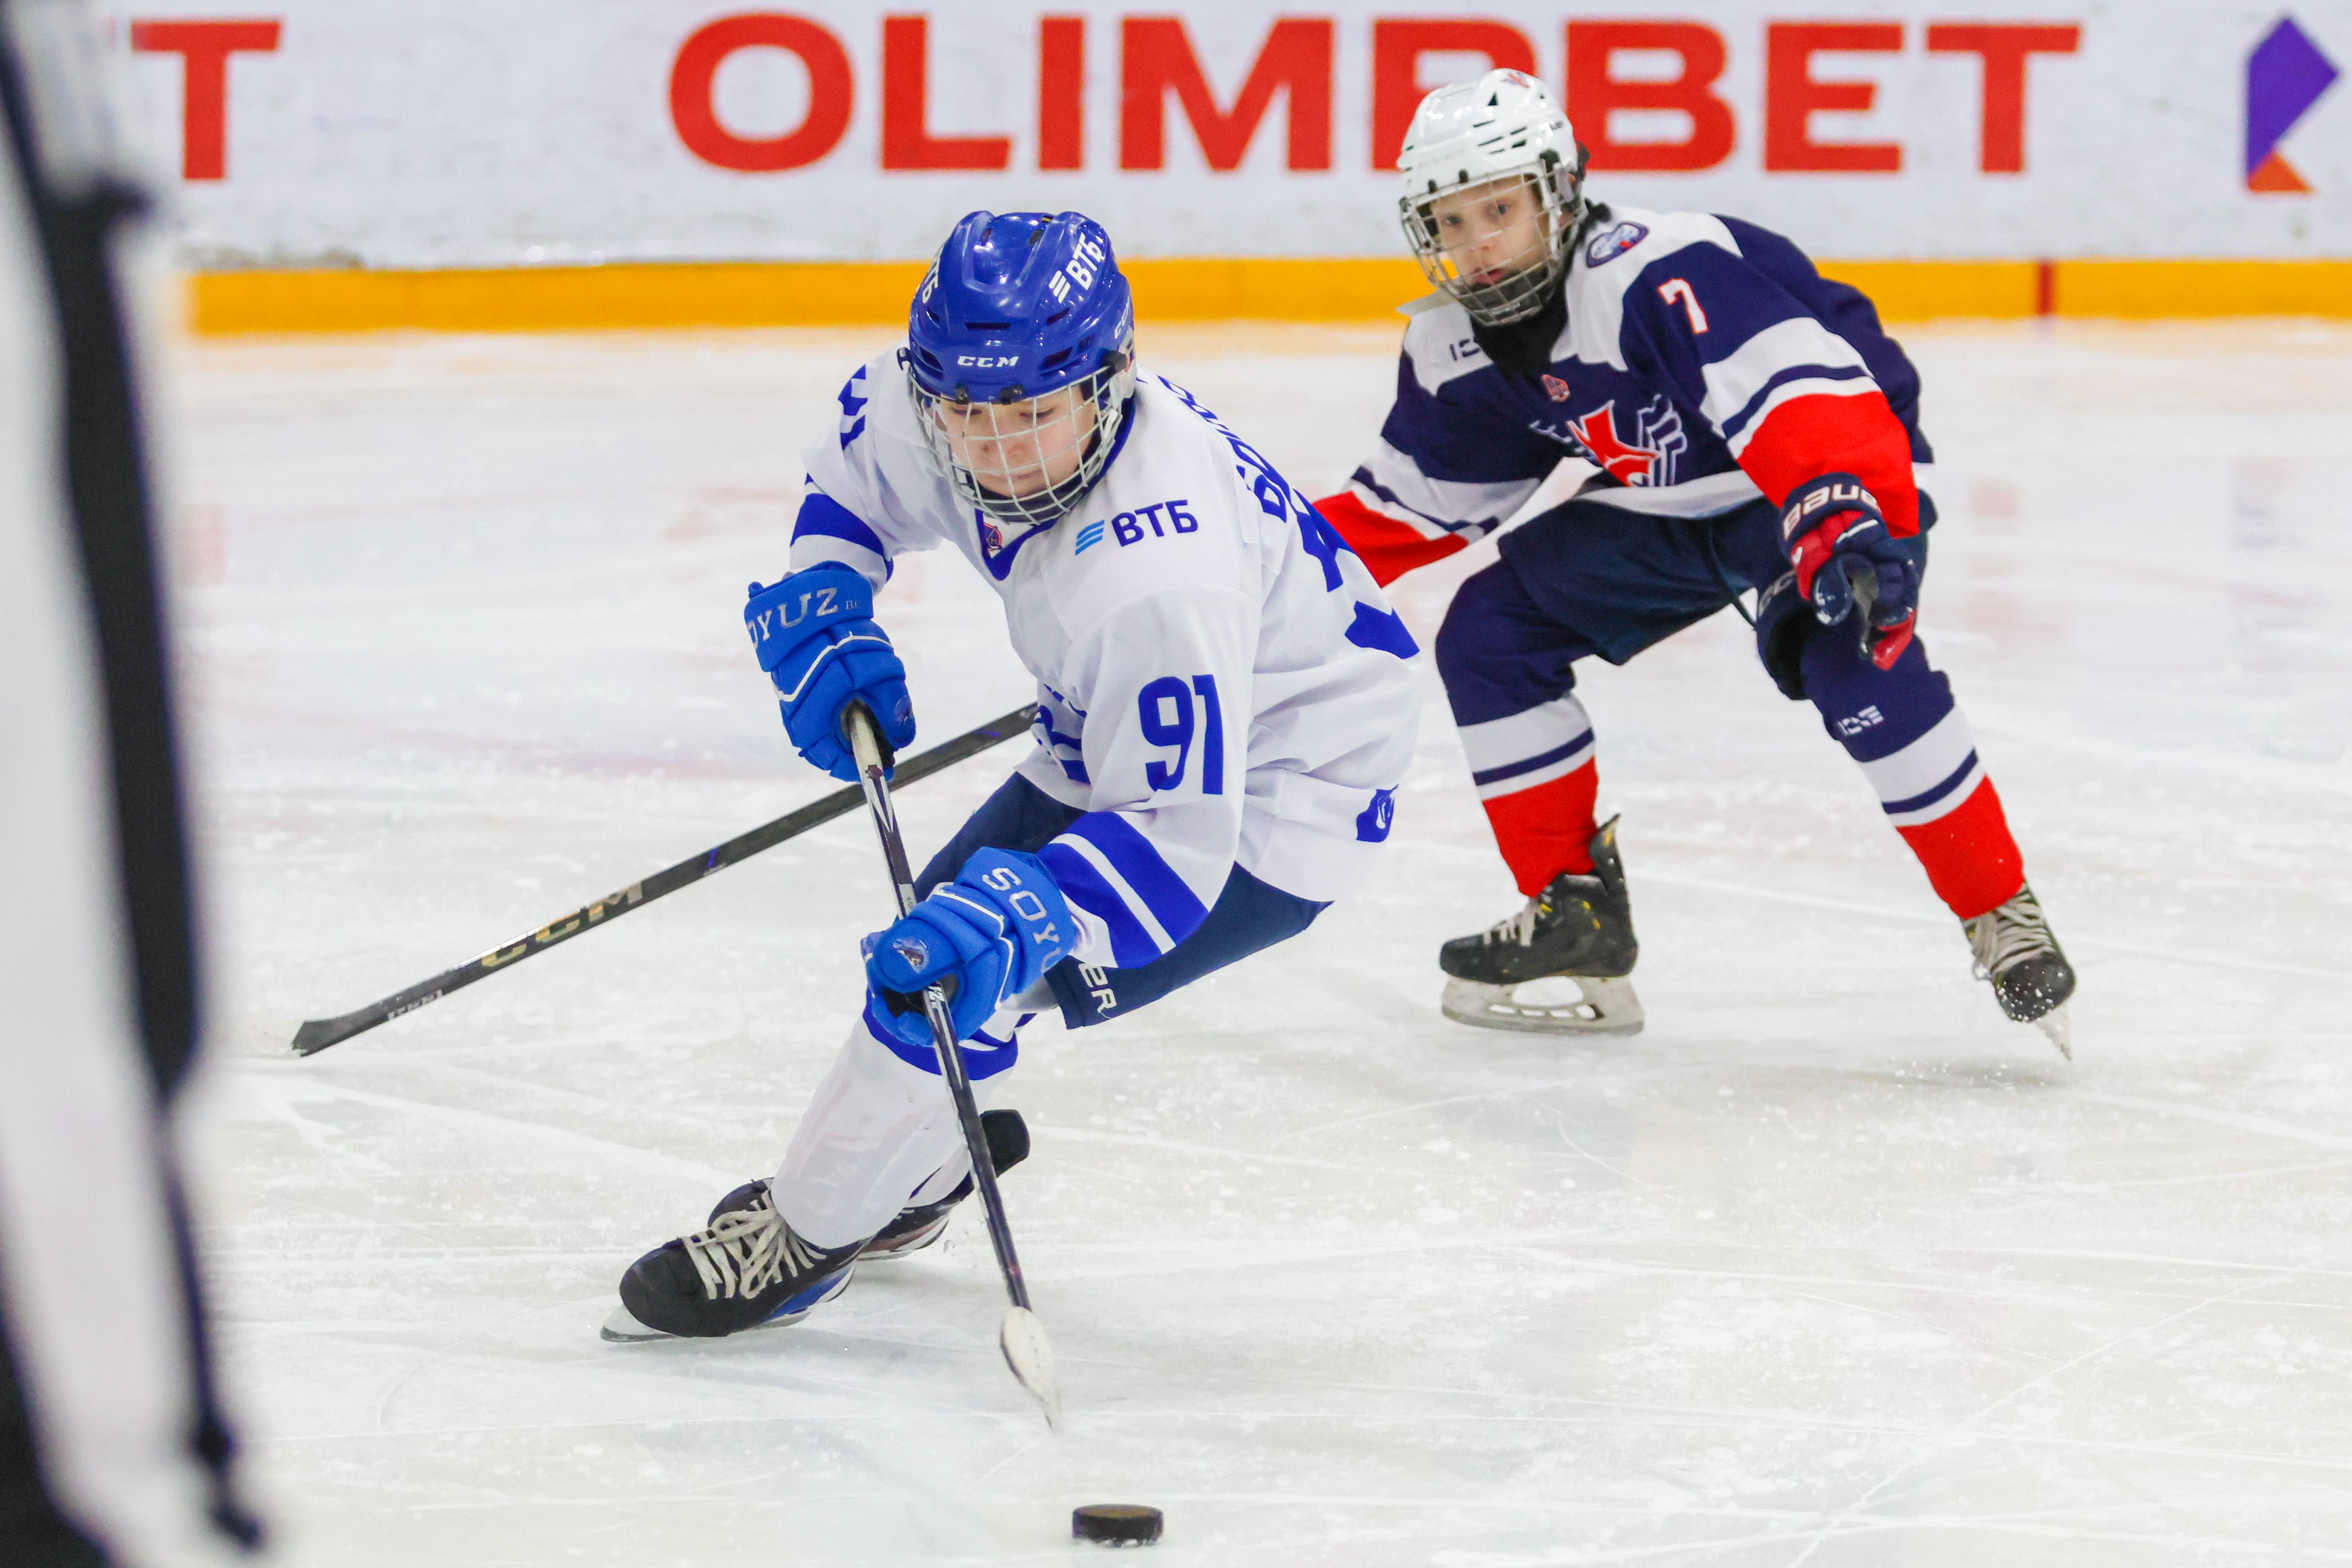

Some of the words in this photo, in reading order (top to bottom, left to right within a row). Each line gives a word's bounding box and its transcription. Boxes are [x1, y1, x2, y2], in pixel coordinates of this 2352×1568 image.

[668, 12, 2080, 173] OLIMPBET
[1657, 277, 1710, 335] 7
[957, 355, 1019, 368] CCM
[1112, 499, 1199, 548] ВТБ
[1137, 674, 1224, 795] 91
[481, 881, 644, 967] CCM
